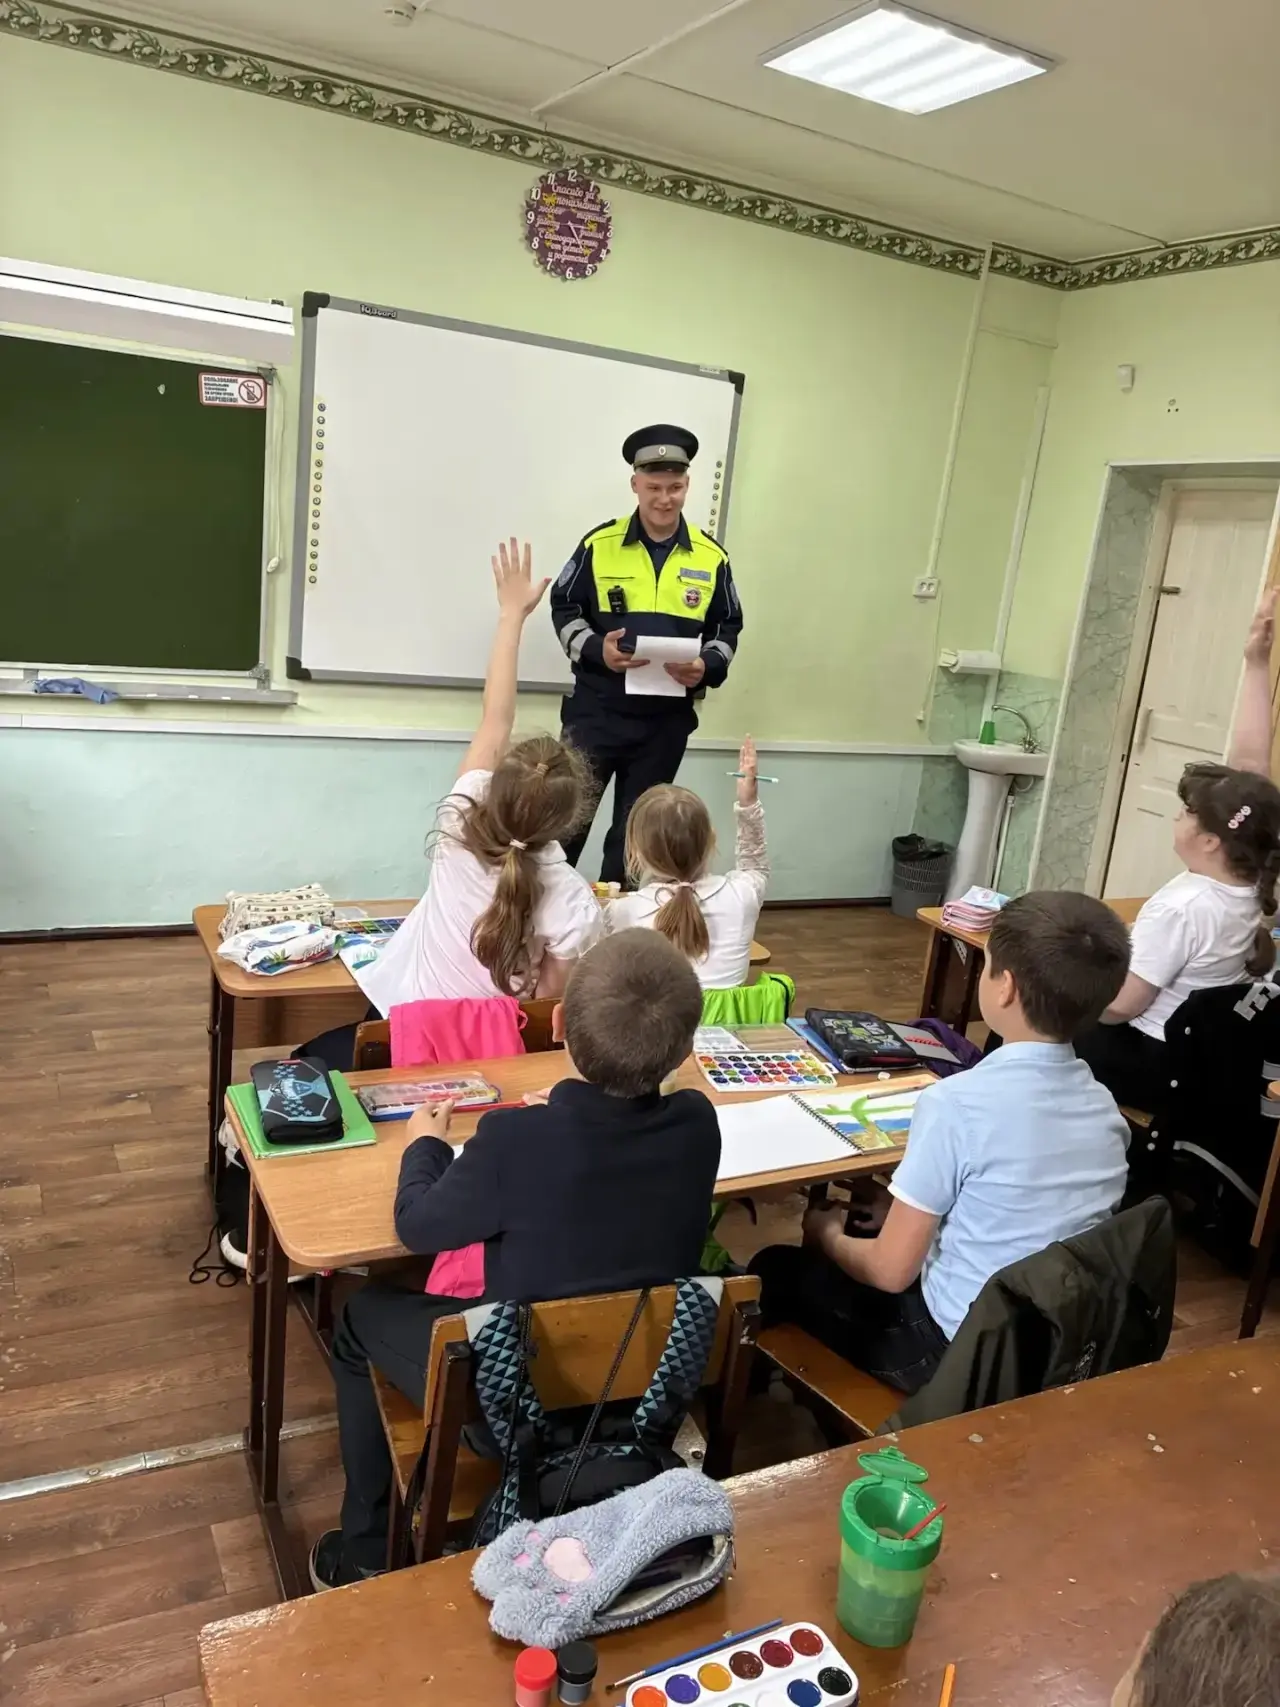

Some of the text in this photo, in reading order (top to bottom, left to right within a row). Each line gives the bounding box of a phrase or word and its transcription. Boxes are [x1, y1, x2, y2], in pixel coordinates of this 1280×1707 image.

[547, 174, 556, 184] 11
[568, 170, 577, 182] 12
[531, 188, 541, 200] 10
[603, 201, 610, 212] 2
[527, 212, 534, 224] 9
[607, 225, 613, 237] 3
[532, 237, 539, 249] 8
[600, 249, 606, 260] 4
[546, 258, 553, 270] 7
[586, 264, 593, 276] 5
[566, 267, 573, 279] 6
